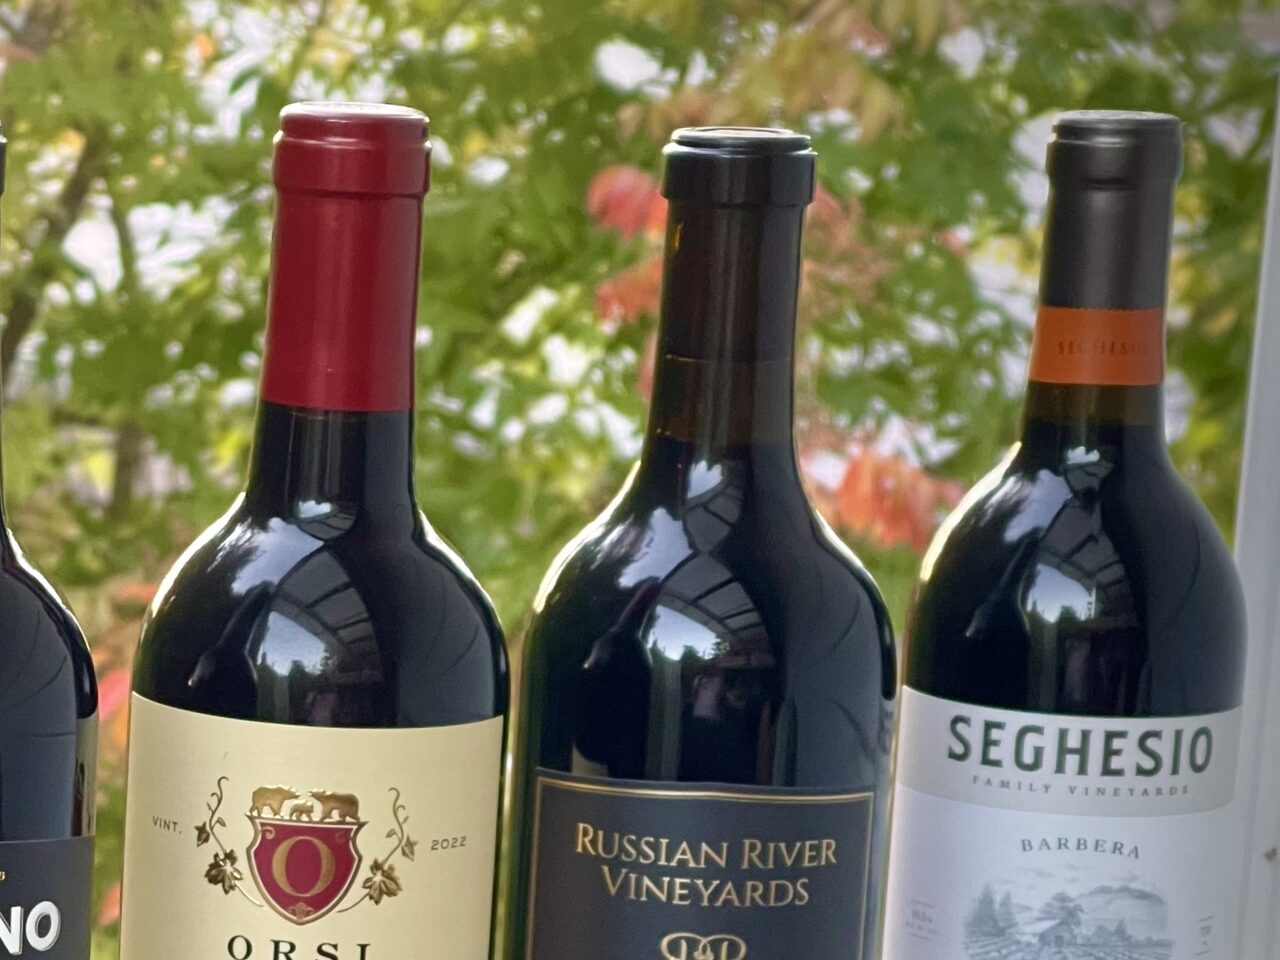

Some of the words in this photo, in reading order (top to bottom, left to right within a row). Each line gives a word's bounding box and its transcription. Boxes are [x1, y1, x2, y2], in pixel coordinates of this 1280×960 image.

[947, 714, 1213, 778] SEGHESIO
[972, 775, 1052, 794] FAMILY
[1067, 784, 1190, 798] VINEYARDS
[152, 815, 183, 835] VINT.
[430, 836, 467, 851] 2022
[576, 821, 727, 870] RUSSIAN
[740, 837, 837, 870] RIVER
[1020, 836, 1141, 860] BARBERA
[271, 835, 336, 898] O
[601, 864, 810, 908] VINEYARDS
